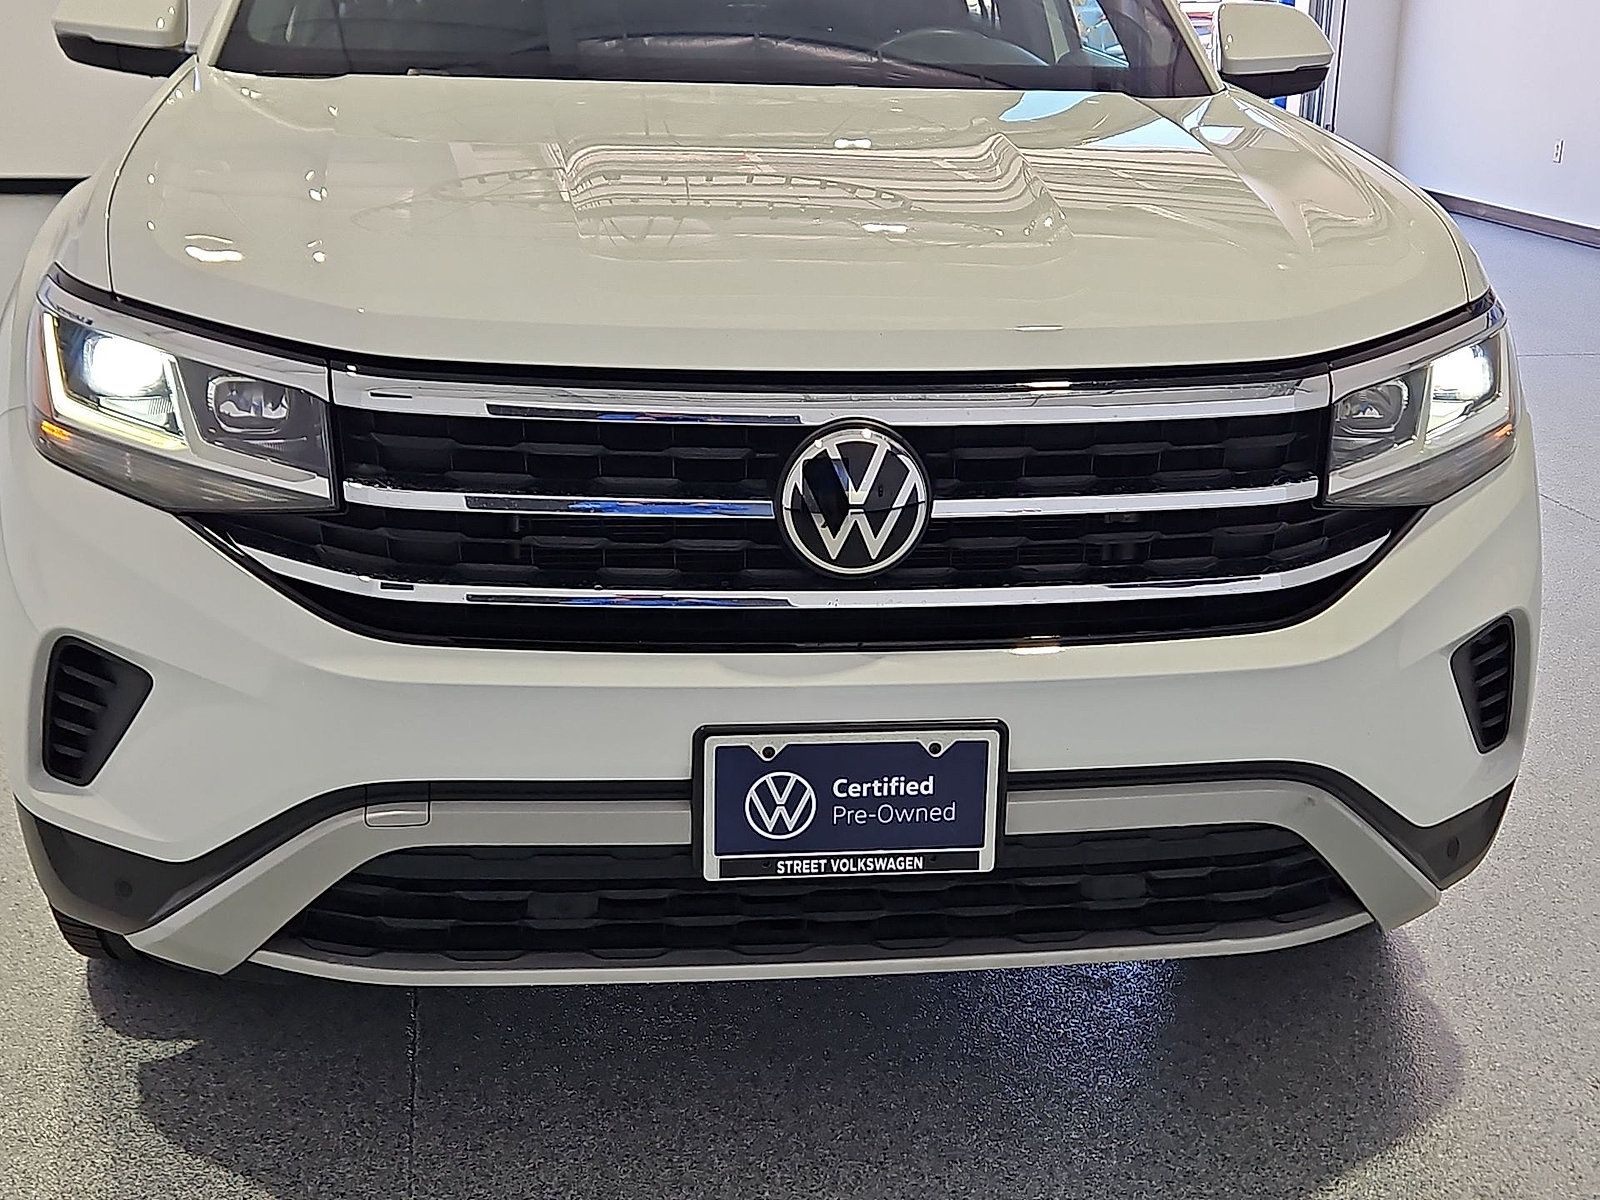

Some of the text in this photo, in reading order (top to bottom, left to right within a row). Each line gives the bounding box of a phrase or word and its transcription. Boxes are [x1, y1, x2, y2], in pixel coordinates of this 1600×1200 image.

[832, 775, 934, 798] Certified
[832, 801, 957, 826] Pre-Owned
[776, 856, 924, 875] STREET VOLKSWAGEN
